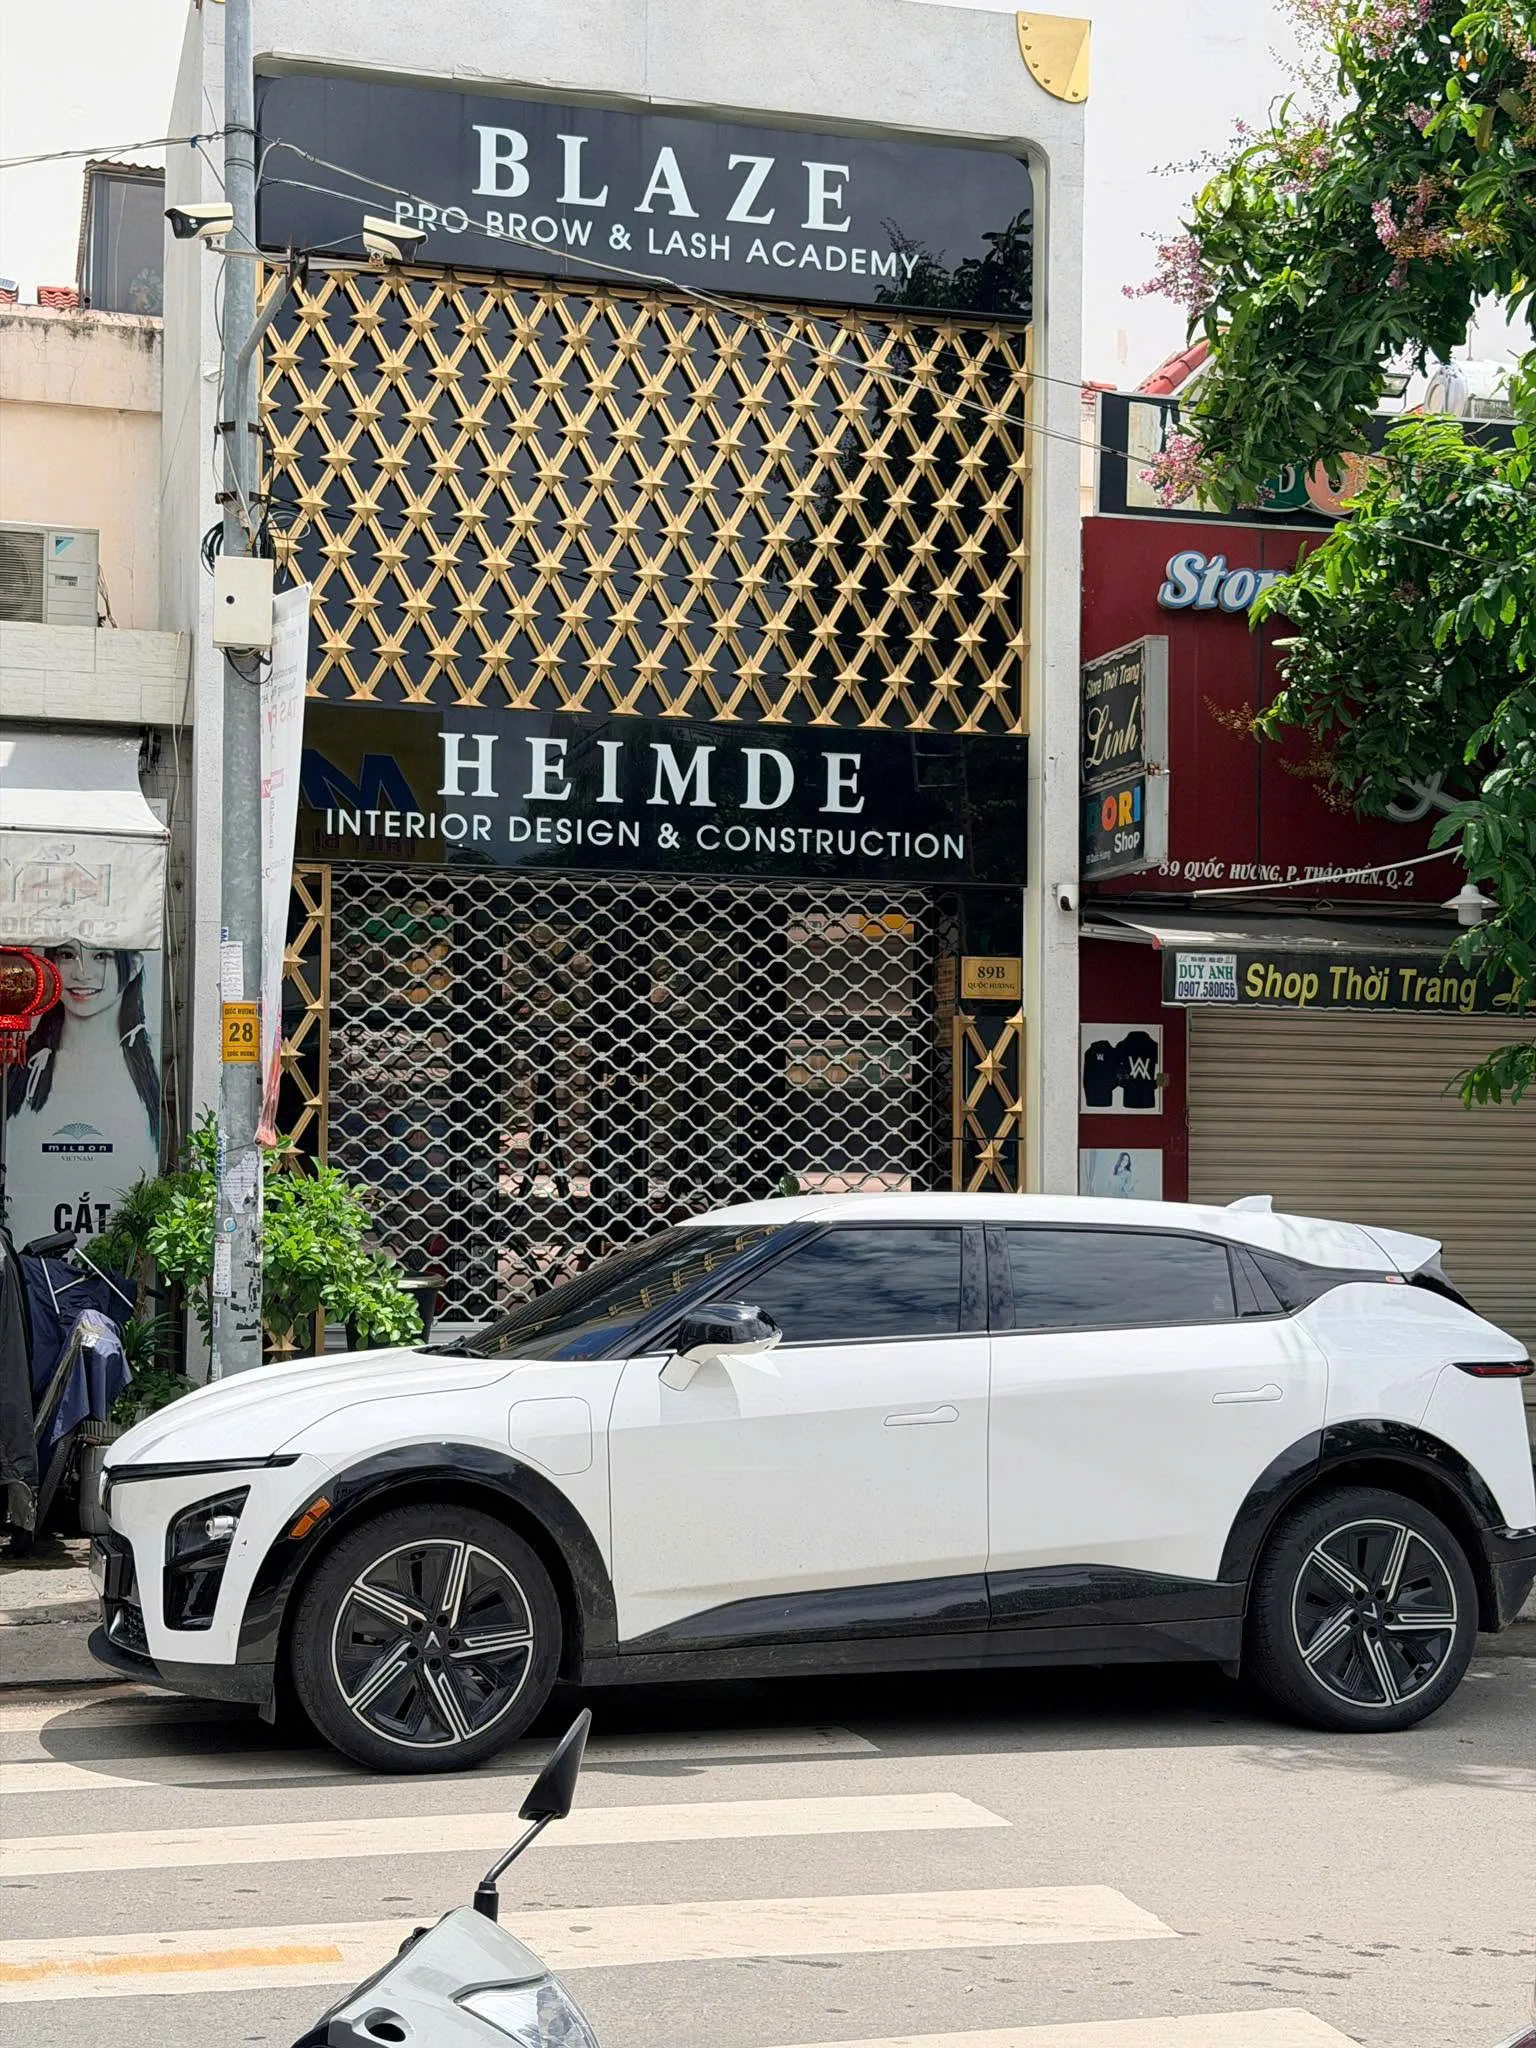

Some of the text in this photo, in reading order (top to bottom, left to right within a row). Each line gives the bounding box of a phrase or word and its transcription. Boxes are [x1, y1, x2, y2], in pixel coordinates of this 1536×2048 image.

[472, 124, 851, 234] BLAZE
[395, 201, 920, 279] PRO BROW & LASH ACADEMY
[1119, 661, 1141, 686] Trang
[1085, 696, 1139, 769] Linh
[437, 732, 865, 814] HEIMDE
[327, 808, 965, 859] INTERIOR DESIGN & CONSTRUCTION
[1114, 832, 1141, 854] Shop
[1158, 861, 1180, 877] 89
[1183, 857, 1225, 881] QUỐC
[977, 965, 1005, 979] 89B
[1179, 964, 1234, 981] DUY ANH
[1245, 962, 1320, 1008] Shop
[1329, 965, 1390, 1001] Thời
[1398, 968, 1477, 1014] Trang
[1178, 981, 1236, 999] 0907.580056
[229, 1022, 254, 1043] 28
[53, 1191, 111, 1234] CẮT
